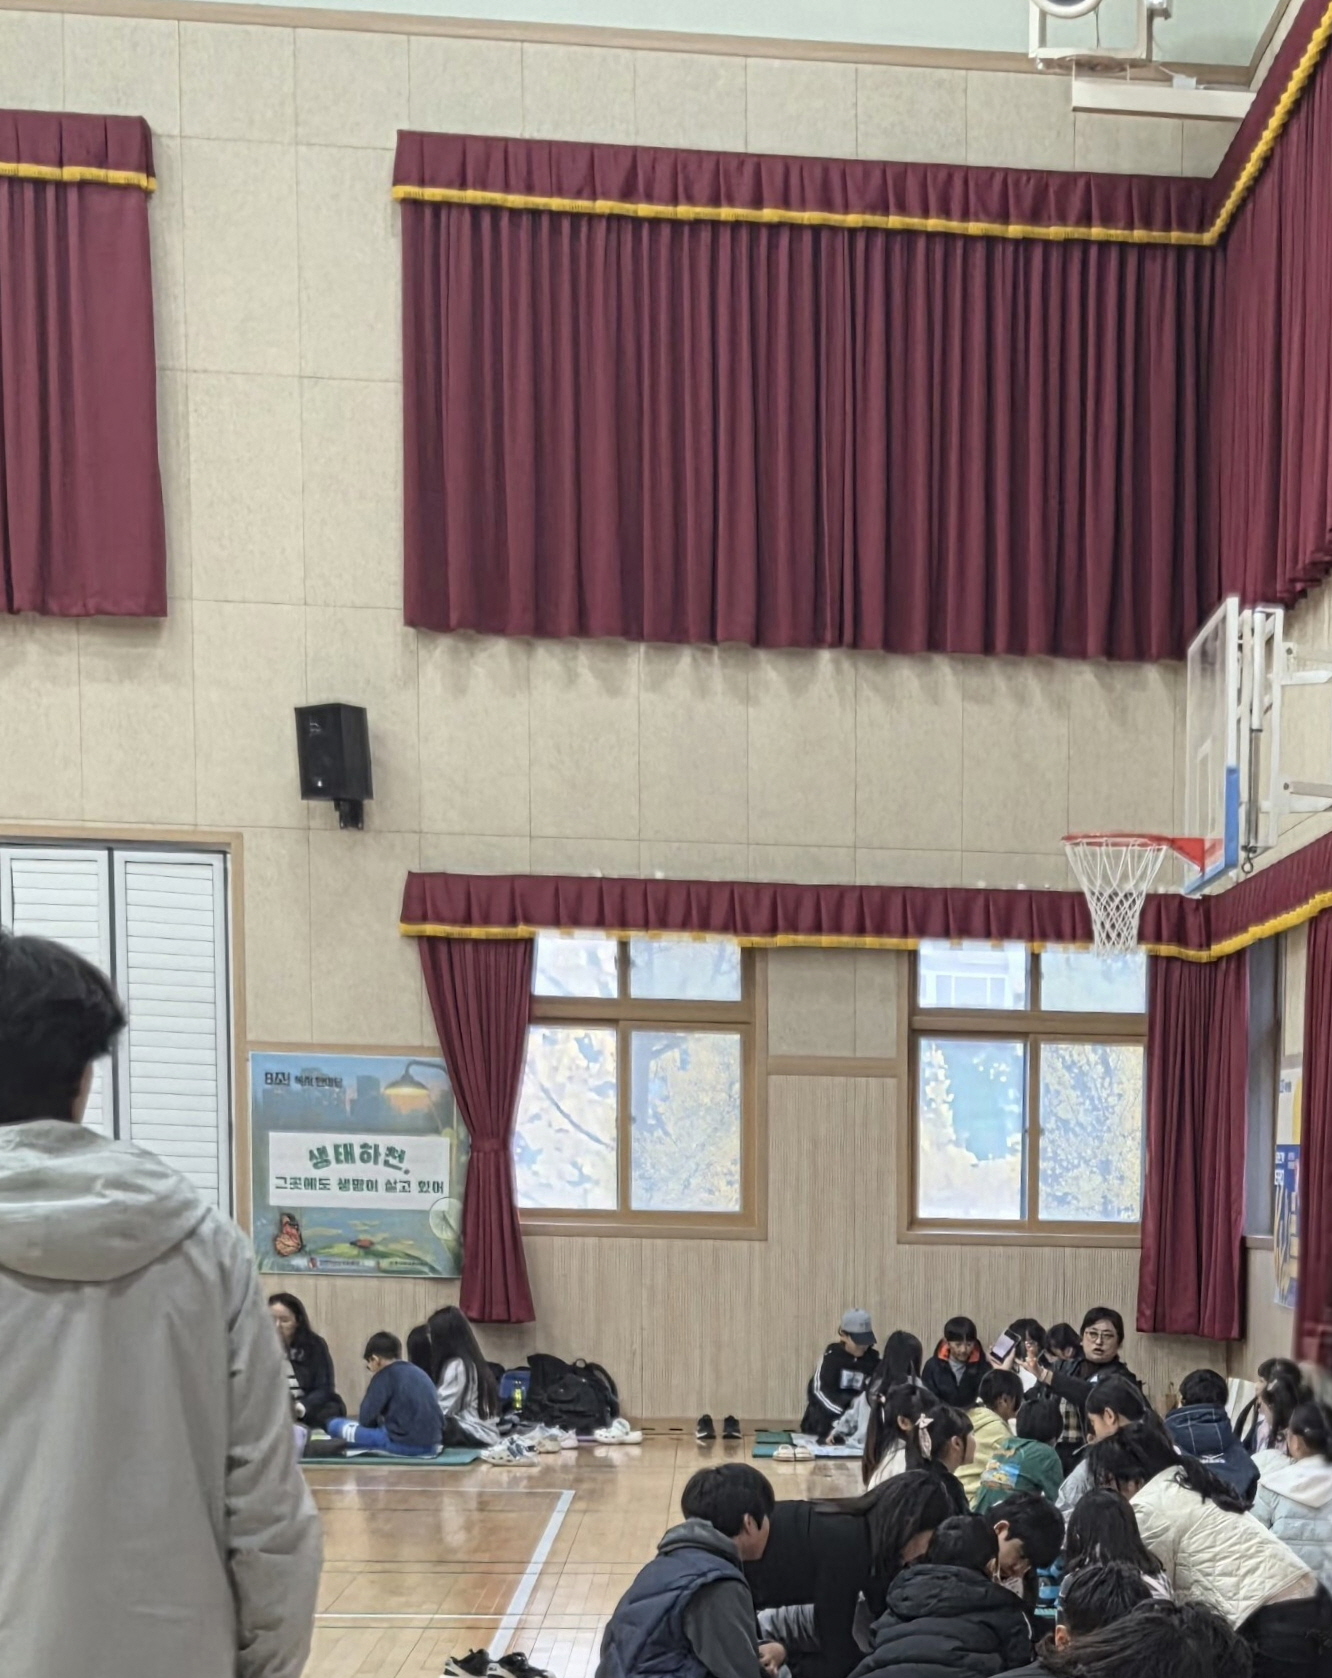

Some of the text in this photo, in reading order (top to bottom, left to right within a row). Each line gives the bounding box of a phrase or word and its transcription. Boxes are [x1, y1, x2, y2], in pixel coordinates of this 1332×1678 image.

[275, 1176, 444, 1194] 그곳에도 생명이 살고 있어
